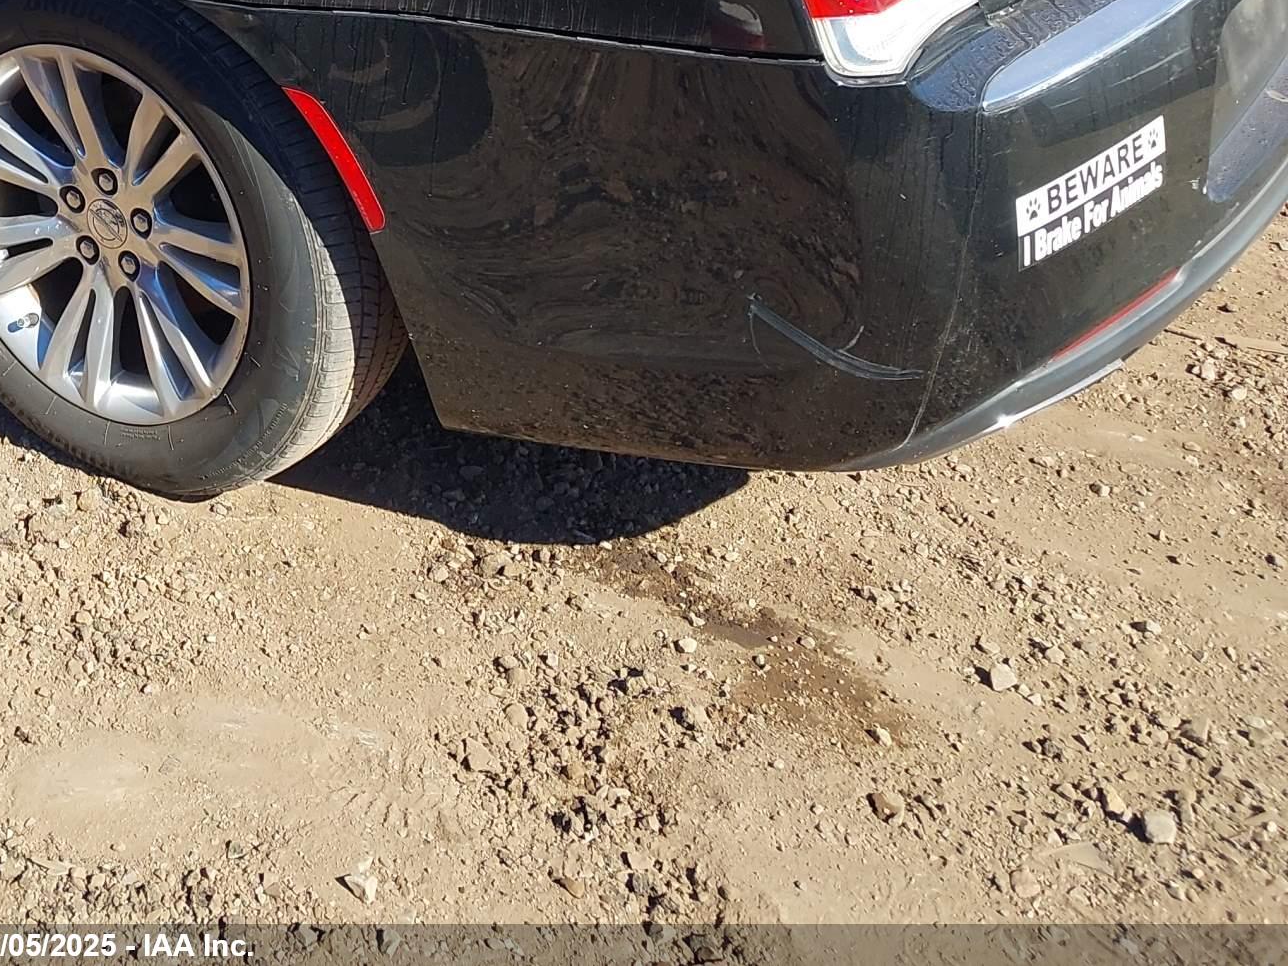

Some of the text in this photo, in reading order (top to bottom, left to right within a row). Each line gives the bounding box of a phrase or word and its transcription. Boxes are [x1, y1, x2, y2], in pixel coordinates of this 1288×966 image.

[1023, 160, 1164, 267] I Brake For Animals
[1047, 133, 1144, 214] BEWARE
